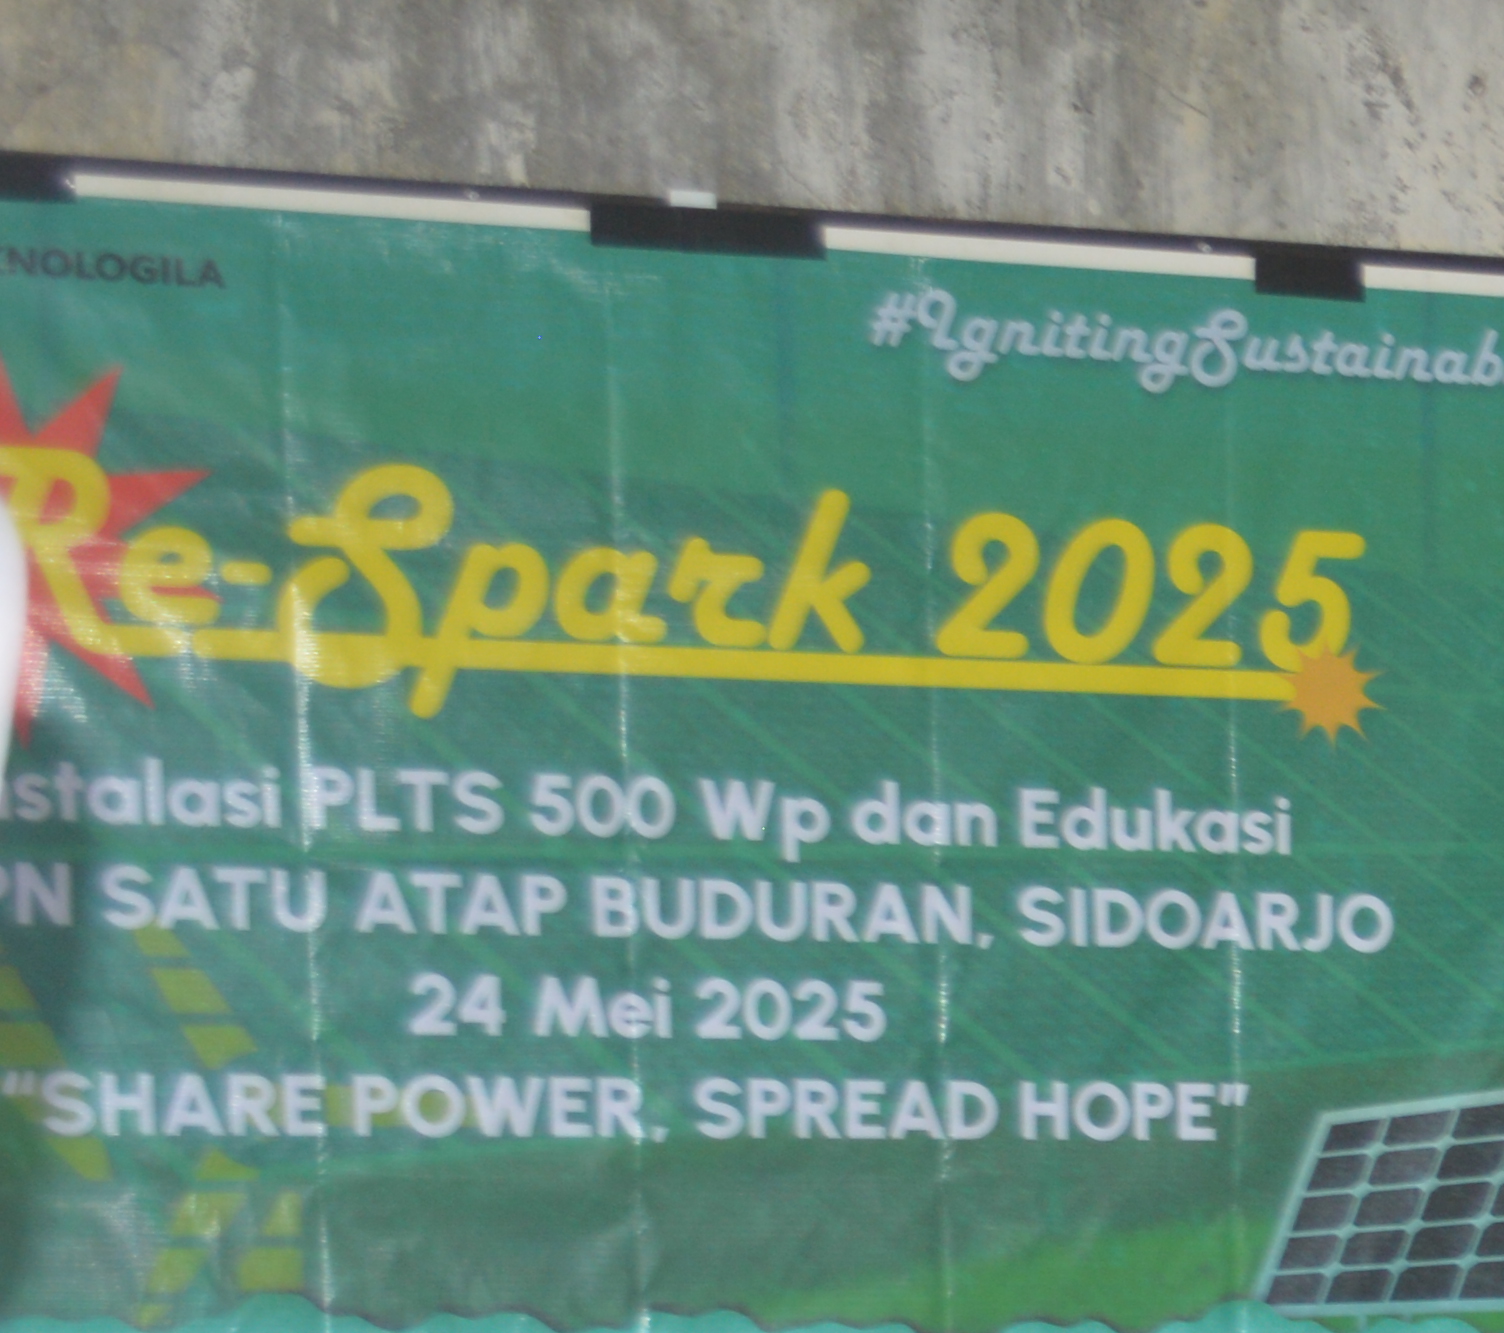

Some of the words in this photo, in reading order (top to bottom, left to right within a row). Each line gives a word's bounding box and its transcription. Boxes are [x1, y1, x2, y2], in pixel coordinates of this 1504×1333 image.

[0, 248, 226, 290] NOLOGILA
[934, 511, 1367, 672] 2025
[0, 757, 281, 829] stalasi
[311, 768, 503, 835] PLTS
[529, 774, 677, 838] 500
[701, 778, 831, 864] Wp
[853, 781, 999, 848] dan
[1017, 785, 1293, 857] Edukasi
[101, 863, 328, 933] SATU
[355, 872, 568, 940] ATAP
[591, 876, 995, 951] BUDURAN,
[1017, 886, 1396, 955] SIDOARJO
[408, 973, 507, 1037] 24
[533, 976, 674, 1040] Mei
[694, 978, 887, 1044] 2025
[694, 1076, 999, 1142] SPREAD
